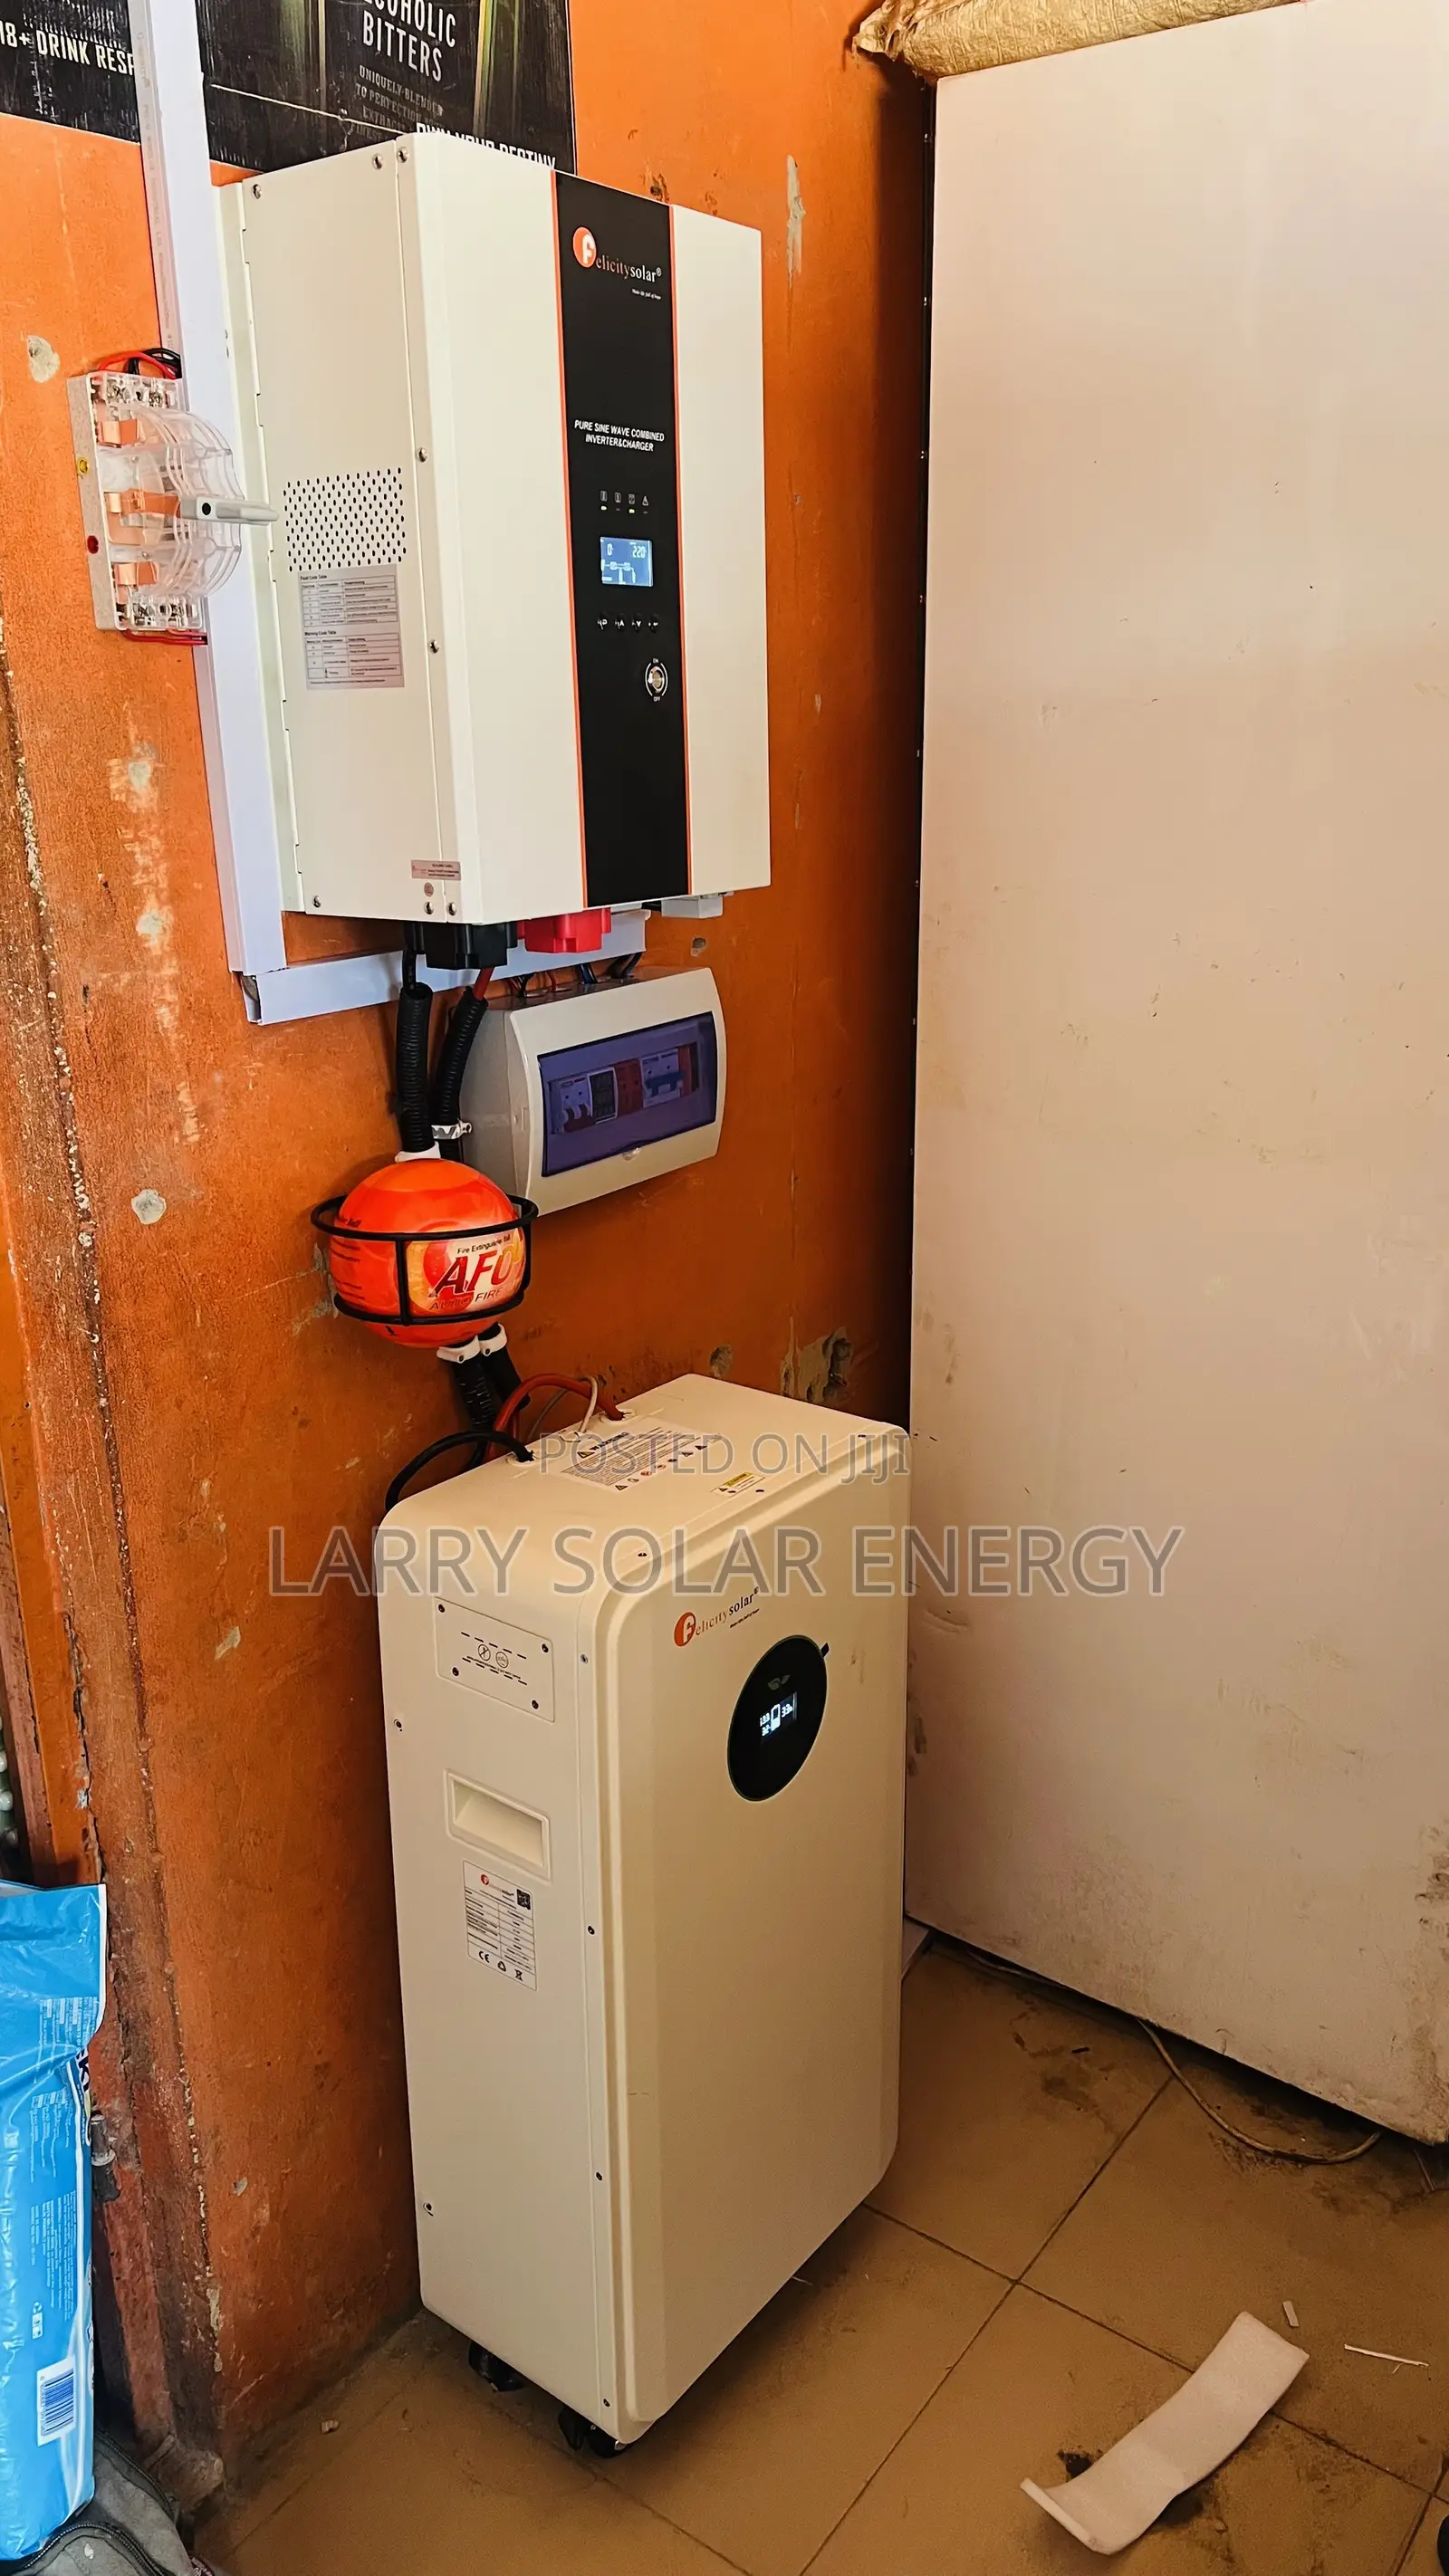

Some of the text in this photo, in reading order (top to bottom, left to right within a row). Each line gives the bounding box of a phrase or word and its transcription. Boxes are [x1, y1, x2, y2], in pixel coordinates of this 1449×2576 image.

[36, 29, 91, 65] DRINK
[362, 9, 442, 82] BITTERS
[355, 82, 368, 99] TO
[359, 64, 403, 96] UNIQUELY
[574, 419, 665, 442] PURE SINE WAVE COMBINED
[585, 434, 654, 452] INVERTER&CHARGER
